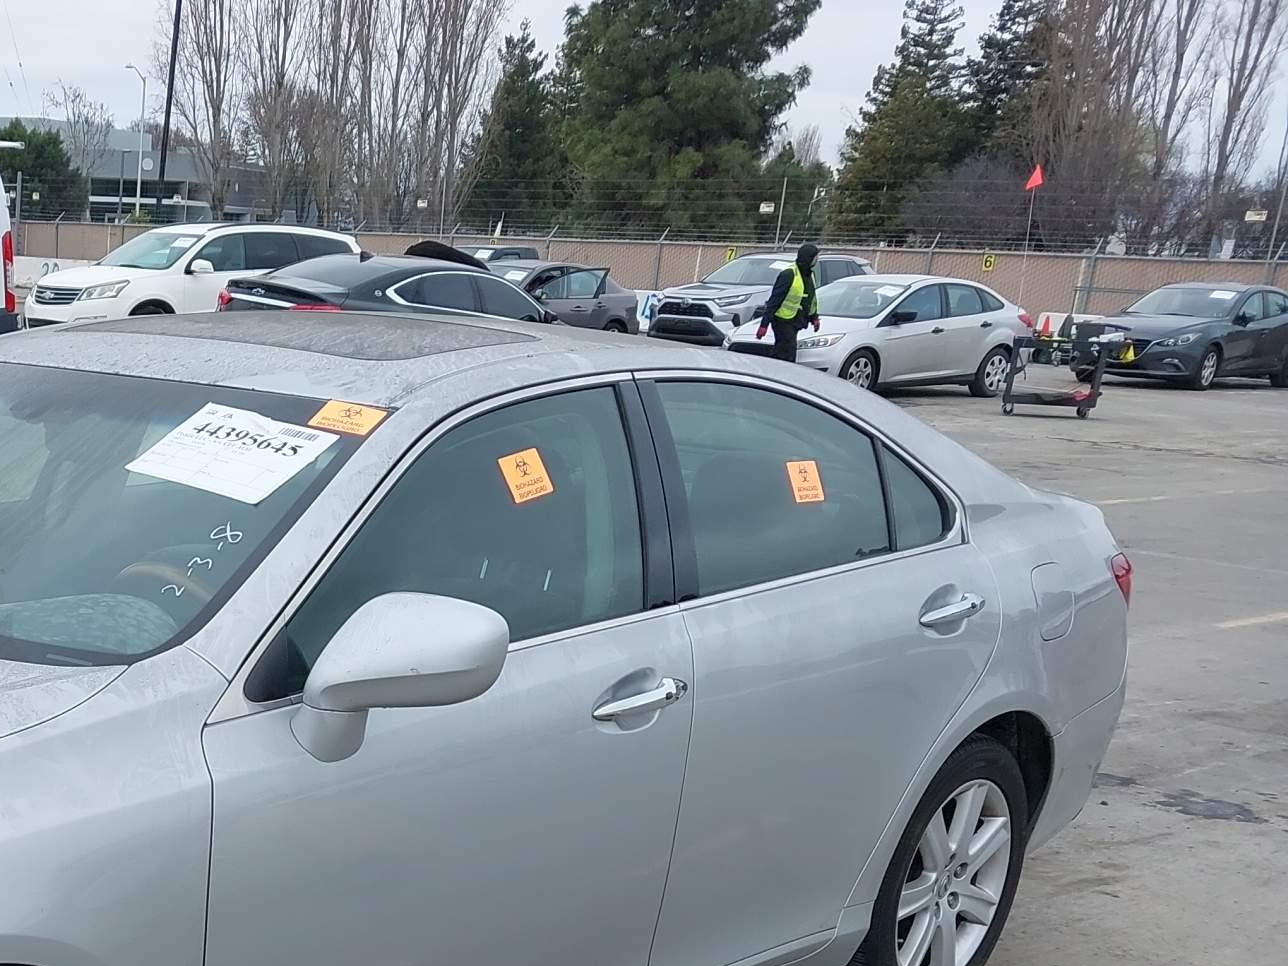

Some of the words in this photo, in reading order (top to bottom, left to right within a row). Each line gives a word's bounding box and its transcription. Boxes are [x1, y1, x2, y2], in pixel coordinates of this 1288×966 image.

[727, 248, 736, 260] 7
[983, 255, 993, 269] 6
[192, 421, 305, 458] 44395645
